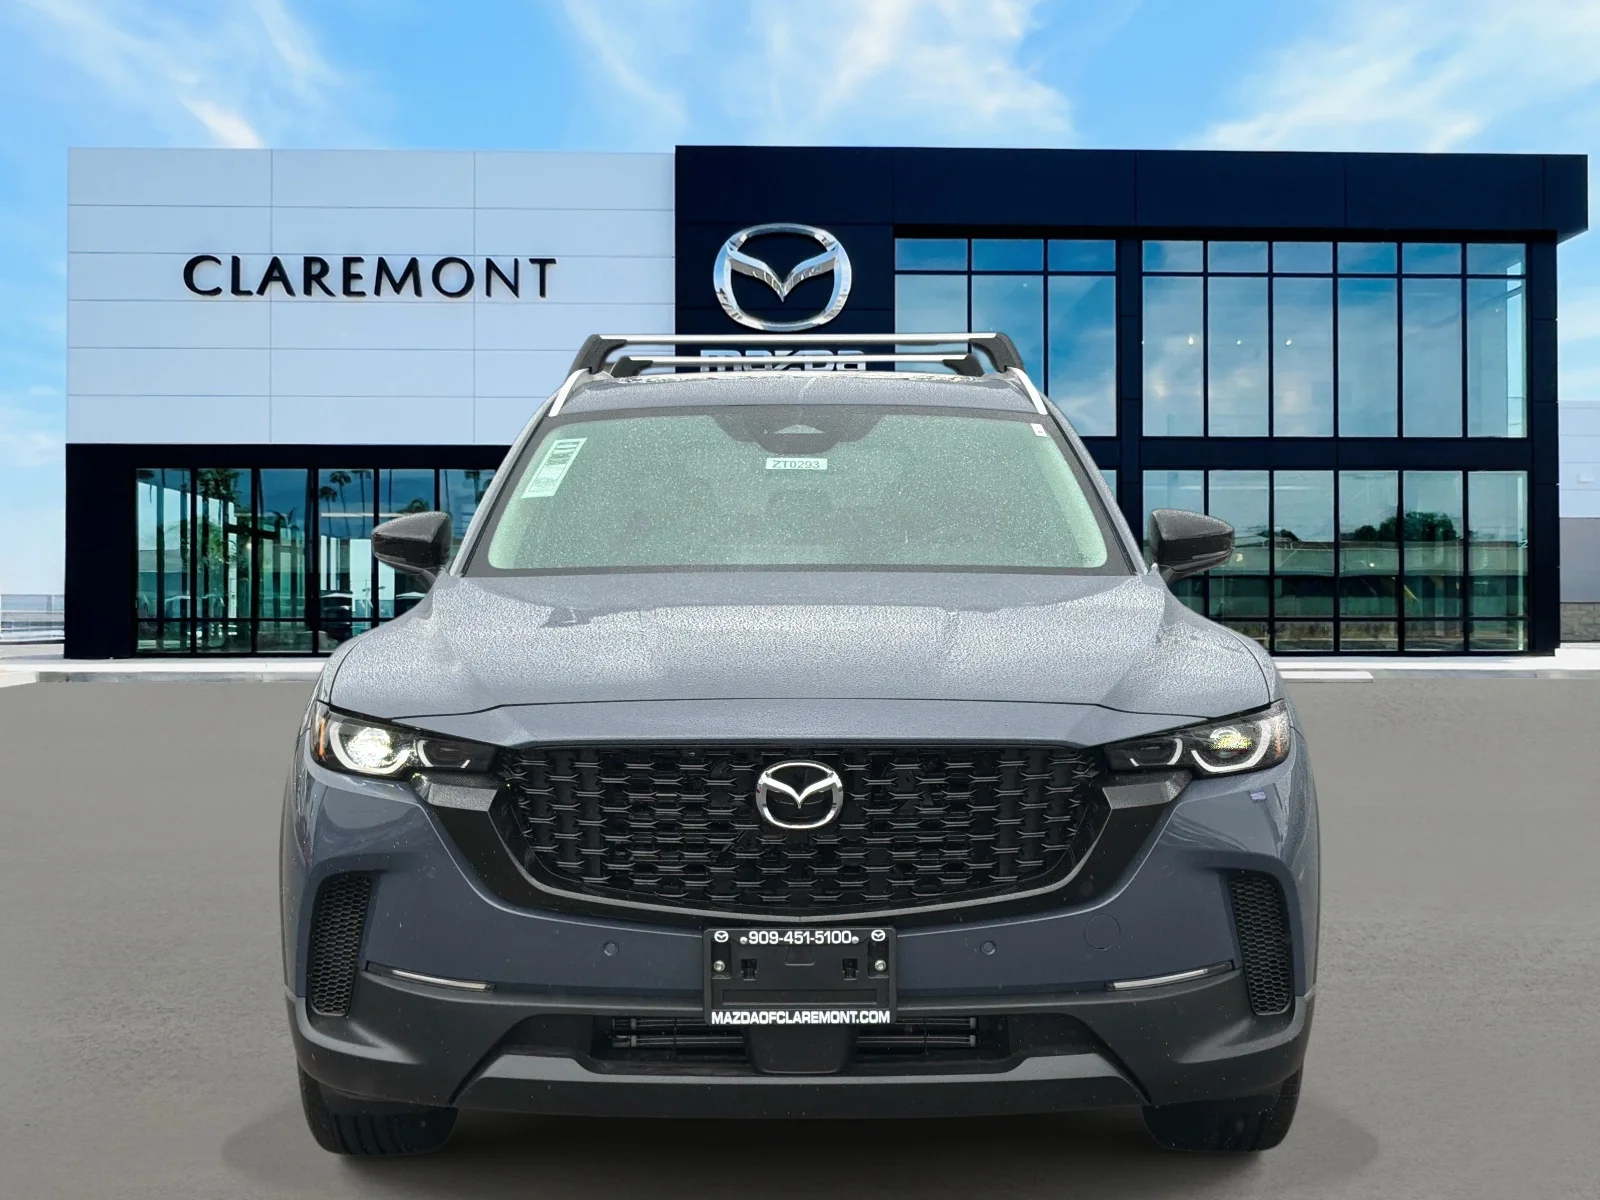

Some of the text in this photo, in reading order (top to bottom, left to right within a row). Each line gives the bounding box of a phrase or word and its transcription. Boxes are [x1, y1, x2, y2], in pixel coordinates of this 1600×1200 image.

[183, 254, 557, 299] CLAREMONT
[772, 460, 820, 469] ZT0293
[748, 930, 852, 945] 909-451-5100
[711, 1010, 891, 1025] MAZDAOFCLAREMONT.COM
